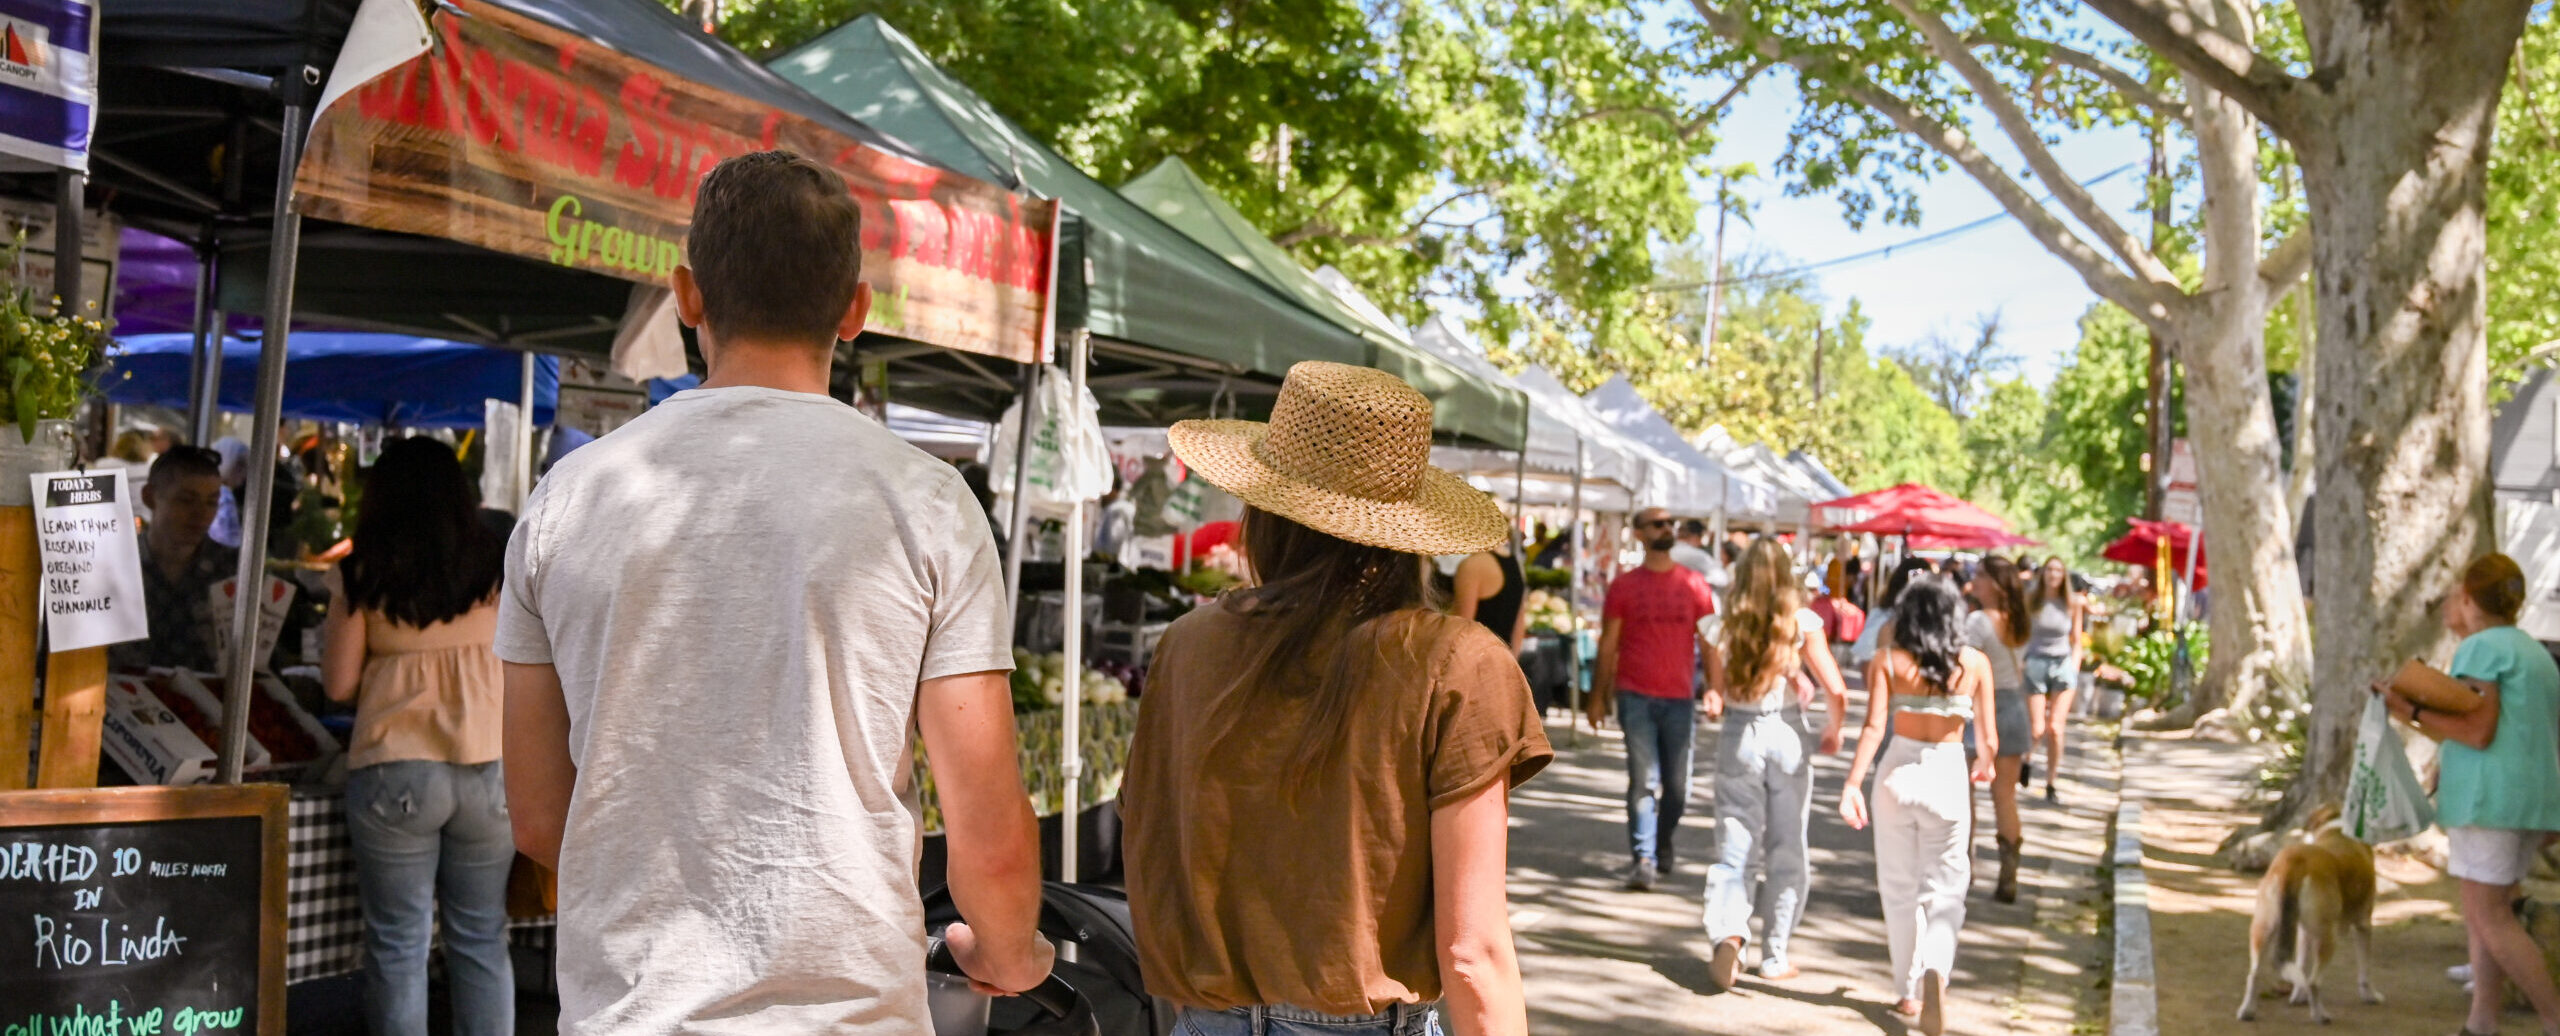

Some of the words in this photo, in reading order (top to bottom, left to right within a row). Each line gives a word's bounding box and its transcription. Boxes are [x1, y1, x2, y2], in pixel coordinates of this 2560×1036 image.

[0, 62, 37, 80] CANOPY
[547, 195, 680, 277] Grown
[53, 477, 94, 492] TODAY'S
[69, 490, 102, 504] HERBS
[42, 517, 77, 535] LEMON
[81, 518, 118, 536] THYME
[44, 539, 95, 559] ROSEMARY
[47, 561, 93, 575] OREGANO
[50, 578, 80, 595] SAGE
[0, 842, 98, 884] OCATED
[112, 847, 141, 878] 10
[149, 861, 189, 878] MILES
[191, 863, 228, 878] NORTH
[74, 886, 104, 911] IN
[33, 913, 92, 970] Rio
[127, 1006, 163, 1036] we
[172, 1005, 244, 1036] grow
